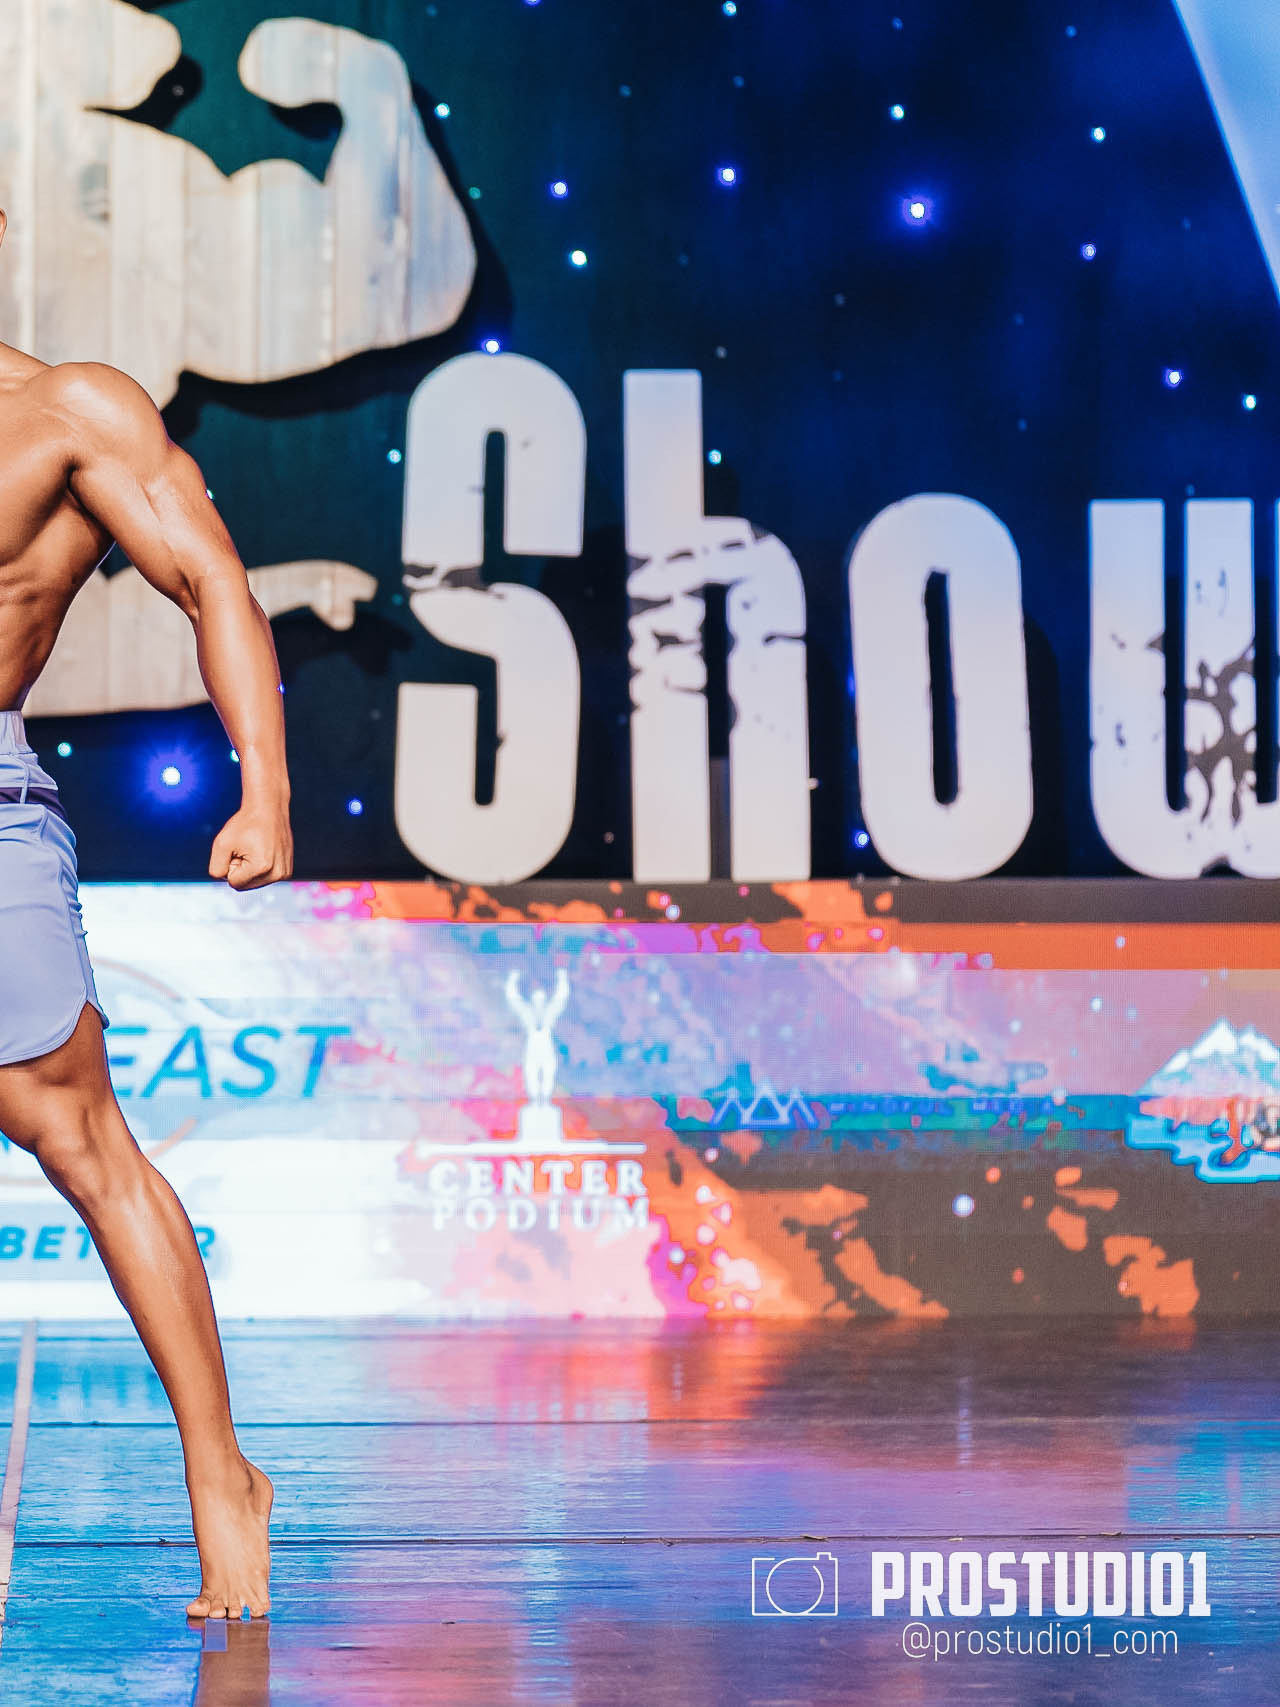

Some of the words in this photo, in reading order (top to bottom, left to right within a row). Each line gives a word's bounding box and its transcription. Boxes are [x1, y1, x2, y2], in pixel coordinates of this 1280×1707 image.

[395, 352, 1280, 885] Show
[428, 1160, 649, 1197] CENTER
[431, 1197, 650, 1233] PODIUM
